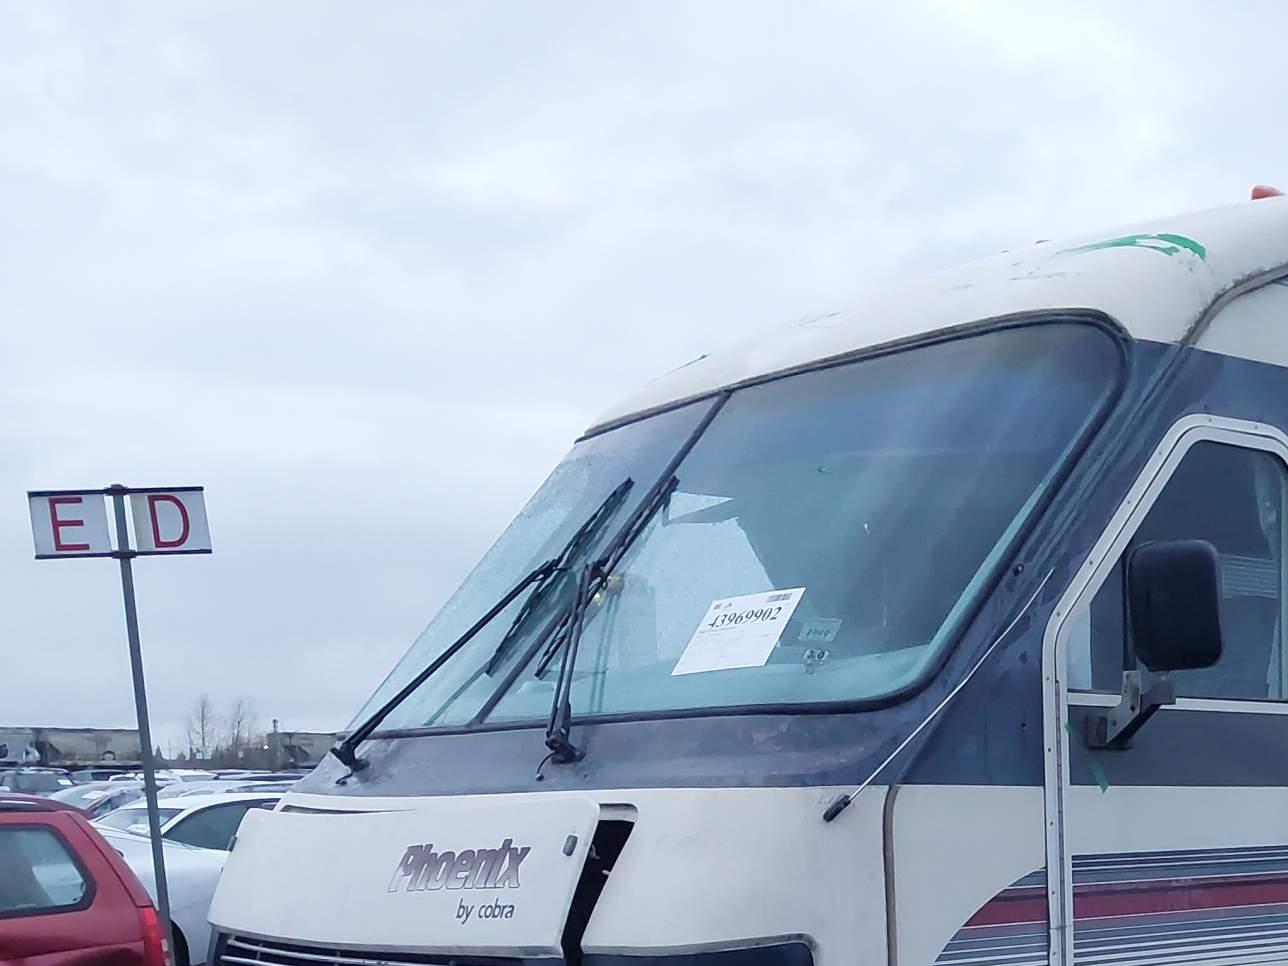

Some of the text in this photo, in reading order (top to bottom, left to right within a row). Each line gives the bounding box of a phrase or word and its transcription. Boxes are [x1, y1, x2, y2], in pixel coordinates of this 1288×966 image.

[48, 496, 90, 551] E
[147, 494, 190, 549] D
[708, 606, 782, 629] 43969902
[387, 838, 532, 893] Phoenix
[455, 897, 515, 925] by cobra
